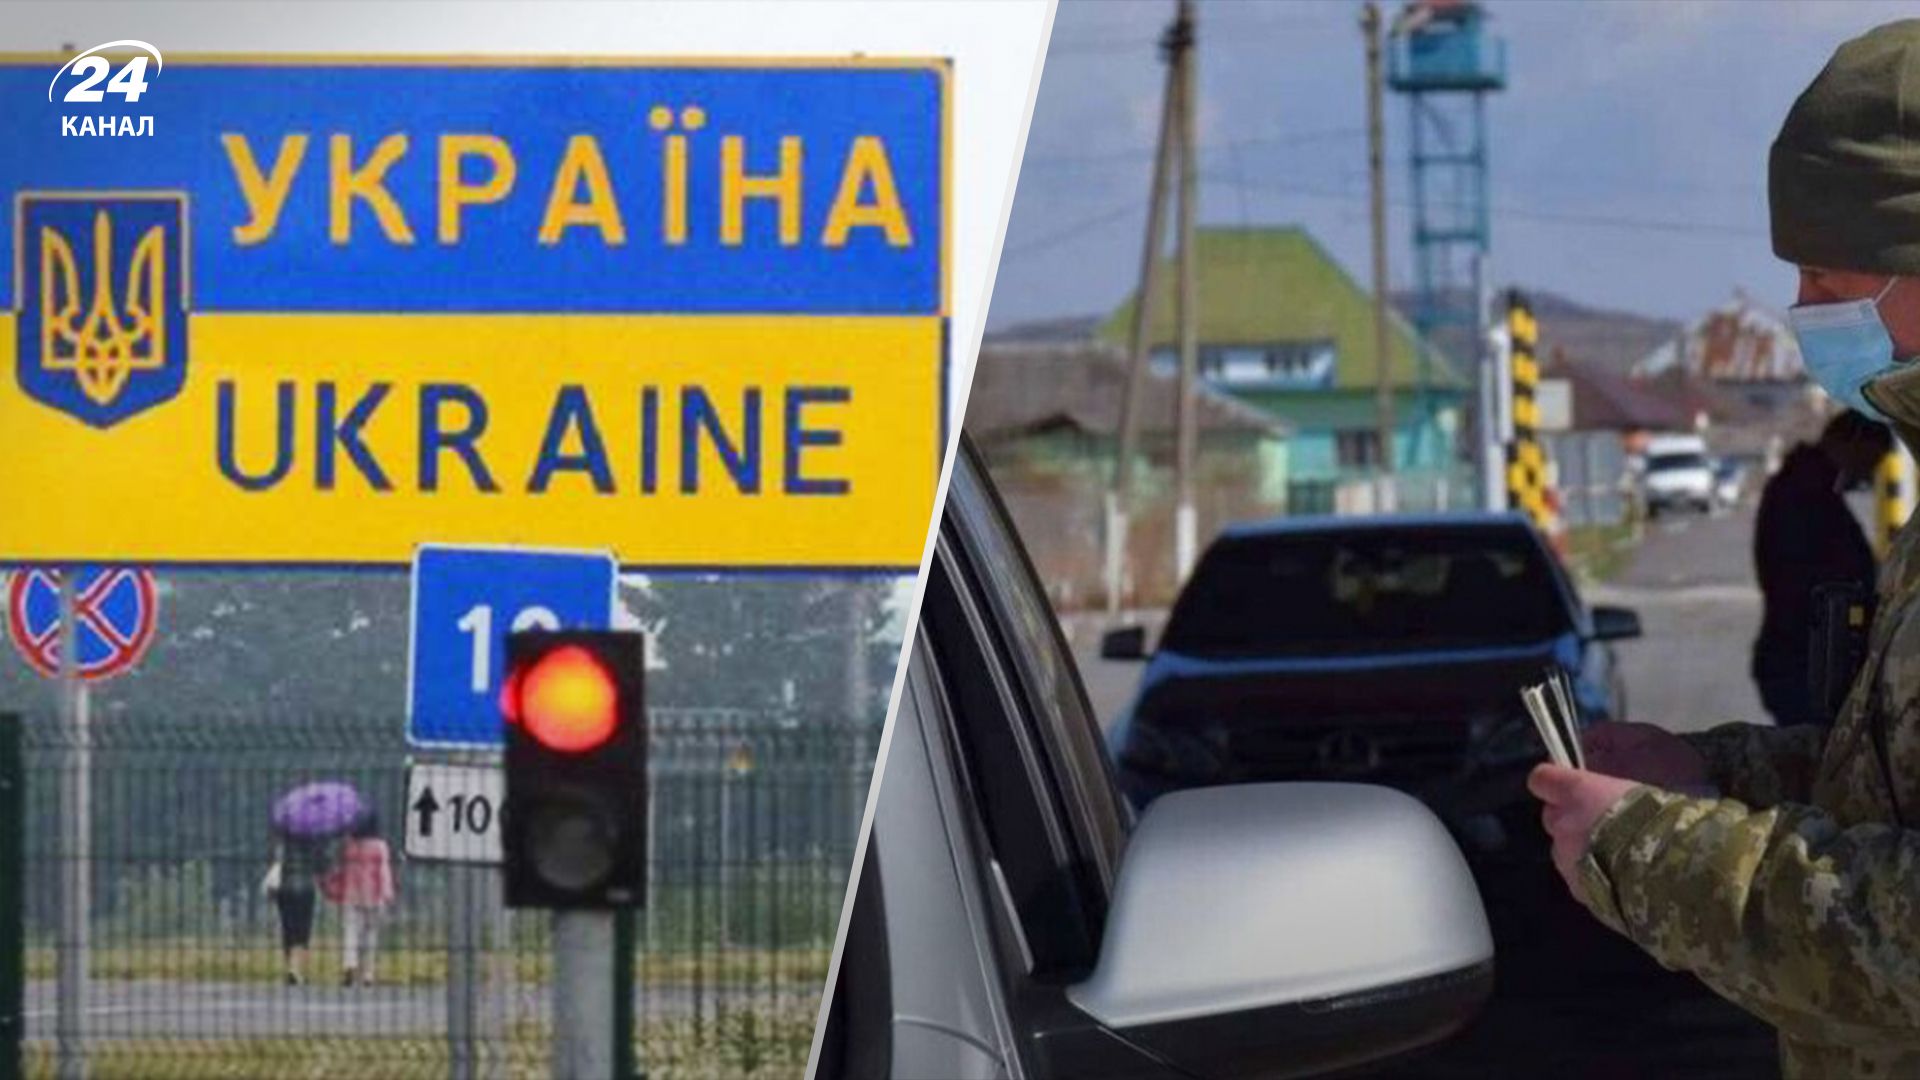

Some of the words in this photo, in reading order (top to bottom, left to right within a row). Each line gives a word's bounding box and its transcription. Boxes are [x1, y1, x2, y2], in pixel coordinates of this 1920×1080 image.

[221, 106, 914, 247] УКРАЇНА
[214, 379, 853, 496] UKRAINE
[457, 604, 562, 694] 1
[447, 793, 506, 836] 10
